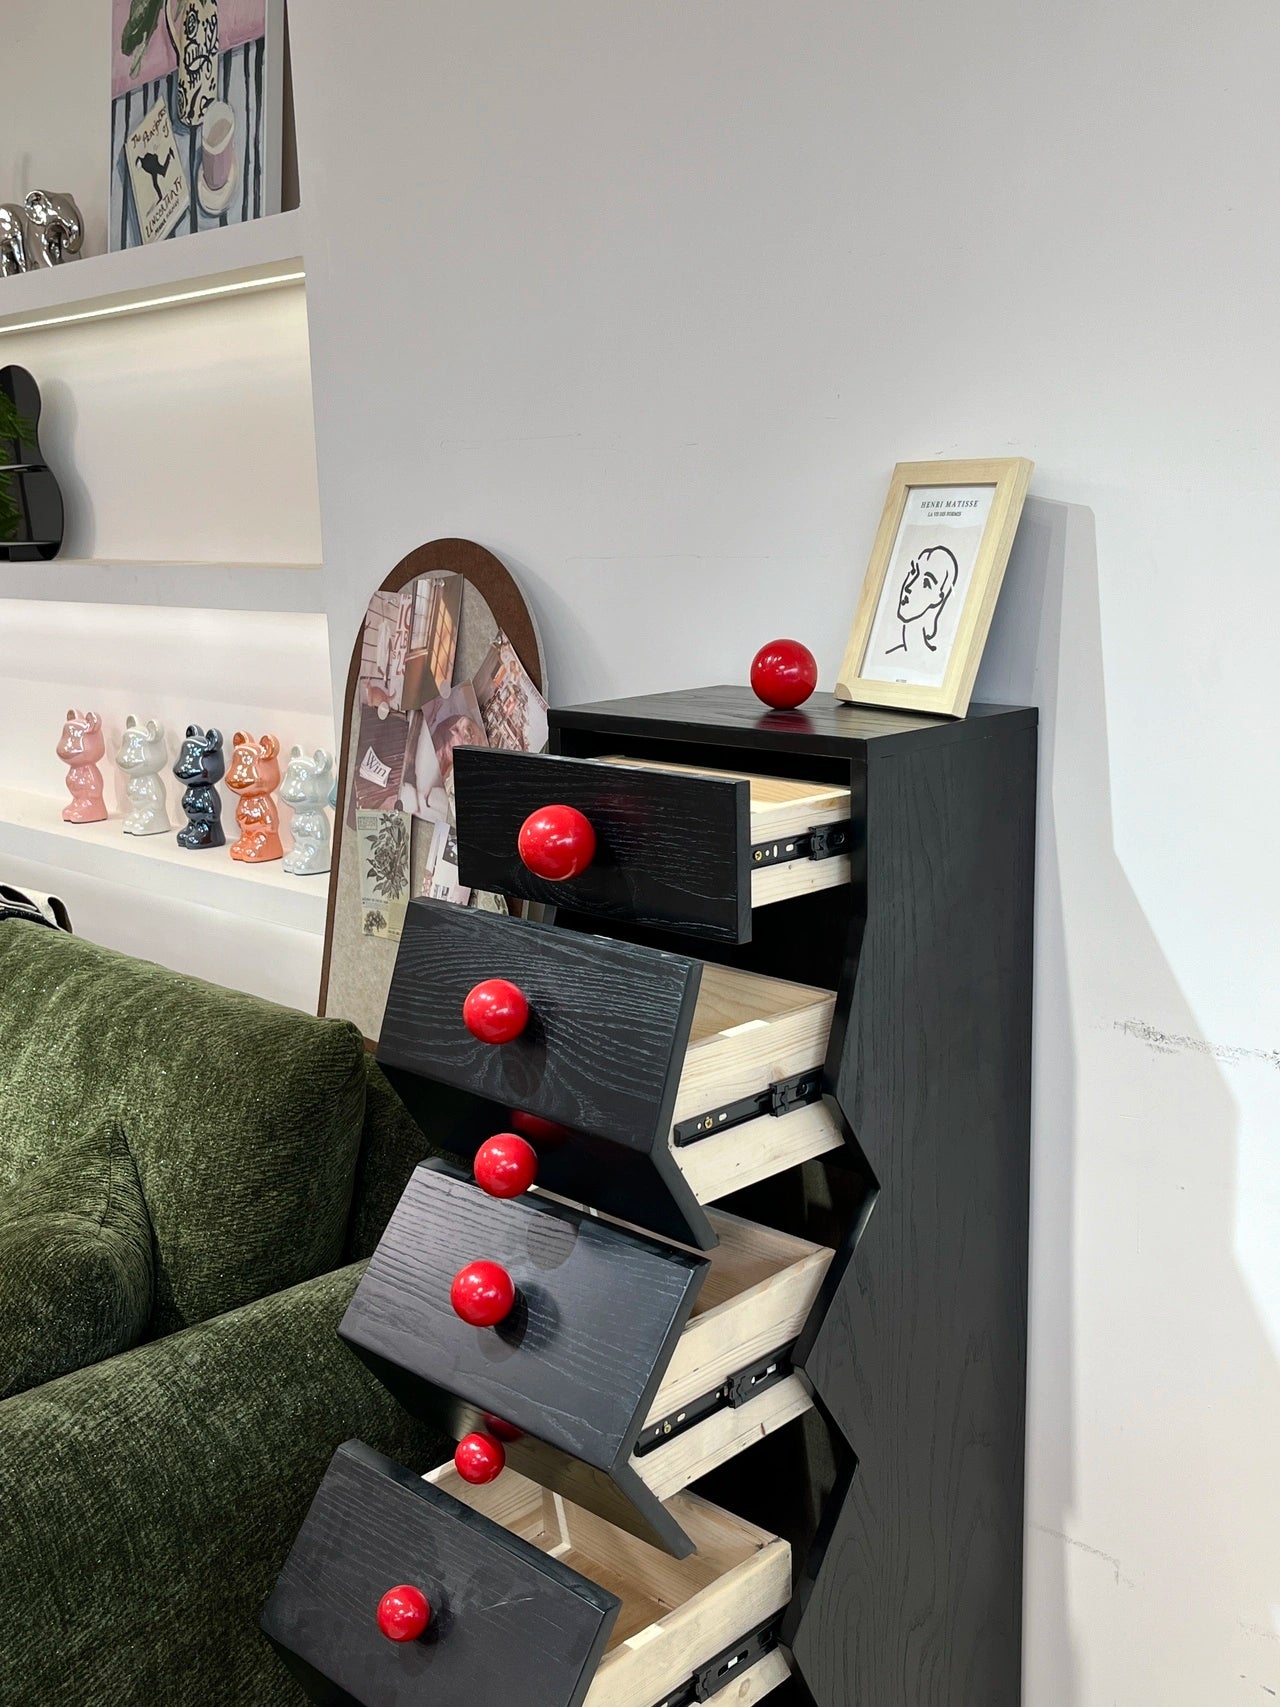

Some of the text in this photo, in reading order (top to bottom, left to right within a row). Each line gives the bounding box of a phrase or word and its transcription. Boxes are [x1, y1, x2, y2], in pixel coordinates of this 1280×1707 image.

[920, 500, 979, 509] HENRI MATISSE
[366, 750, 387, 777] Win
